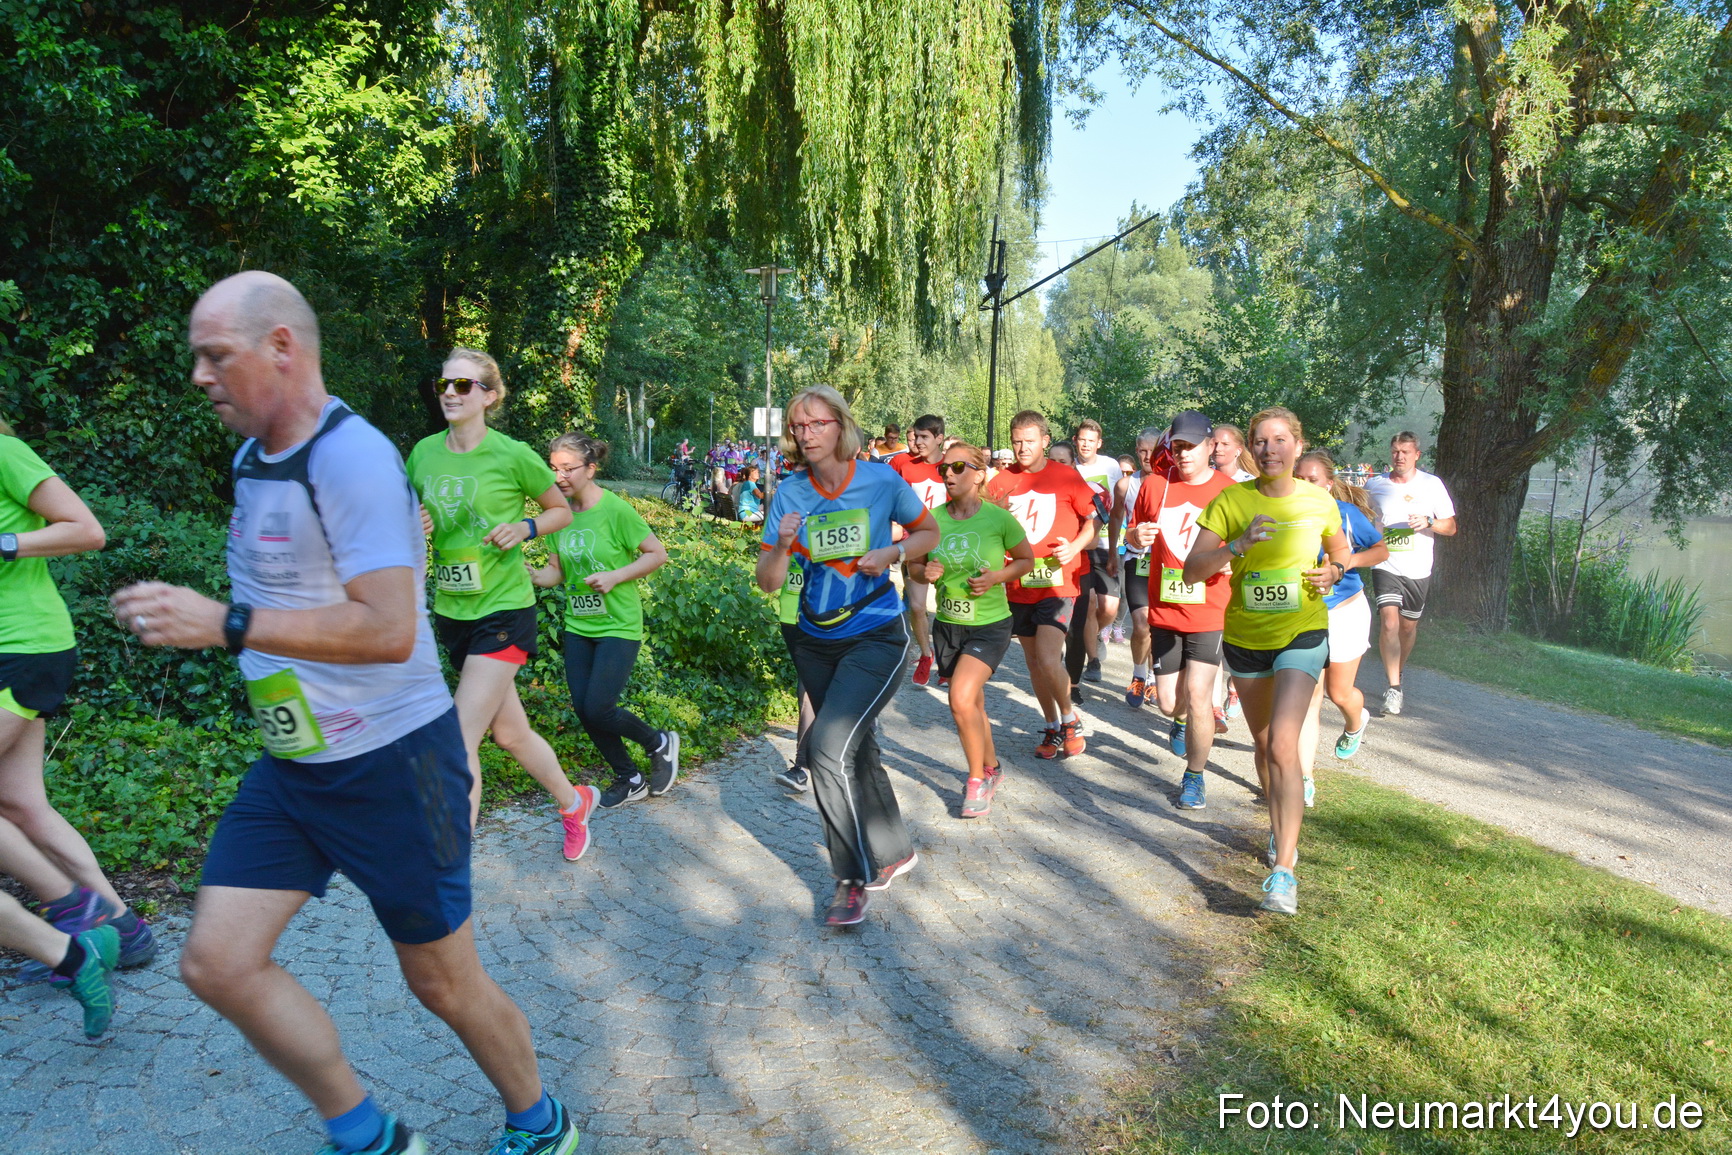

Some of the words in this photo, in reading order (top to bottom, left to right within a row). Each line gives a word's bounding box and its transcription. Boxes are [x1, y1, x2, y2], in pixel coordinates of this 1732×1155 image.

[815, 525, 861, 547] 1583
[435, 564, 473, 582] 2051
[1028, 567, 1053, 580] 416
[571, 594, 602, 609] 2055
[1253, 585, 1288, 602] 959
[941, 595, 971, 614] 2053
